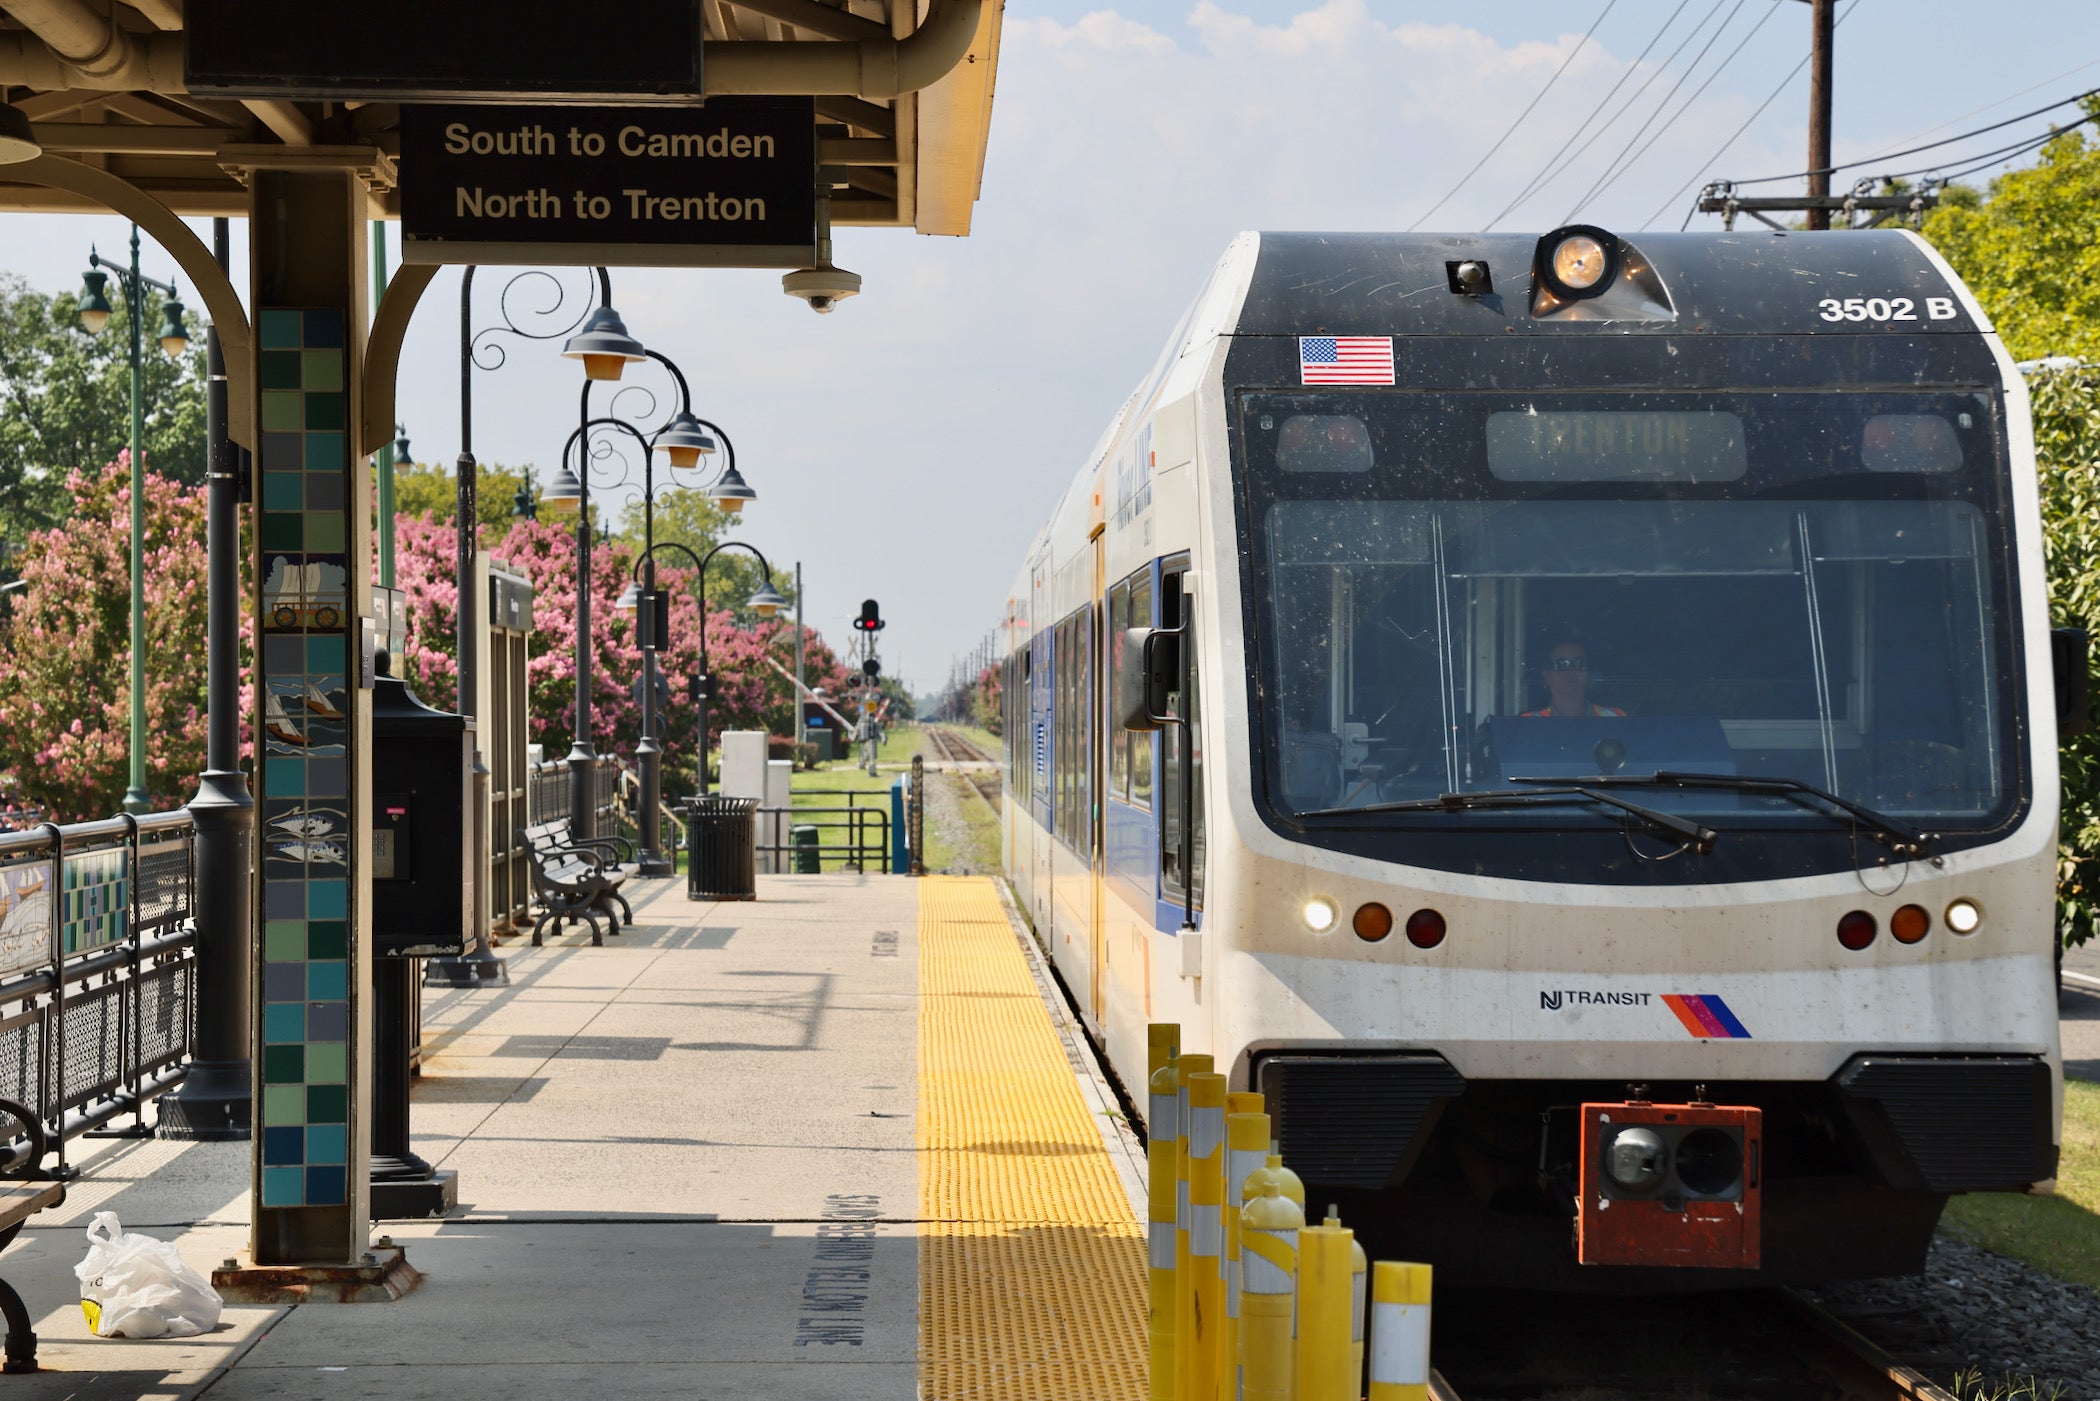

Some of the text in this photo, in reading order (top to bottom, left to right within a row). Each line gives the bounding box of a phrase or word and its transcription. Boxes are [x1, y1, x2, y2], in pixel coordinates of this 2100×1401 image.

[444, 123, 775, 159] South to Camden
[455, 186, 766, 222] North to Trenton
[1818, 297, 1957, 322] 3502 B
[1530, 413, 1687, 454] TRENTON
[1540, 990, 1652, 1010] NJ TRANSIT
[814, 1222, 877, 1261] BEHIND
[801, 1264, 870, 1311] YELLOW
[793, 1317, 865, 1346] LINE
